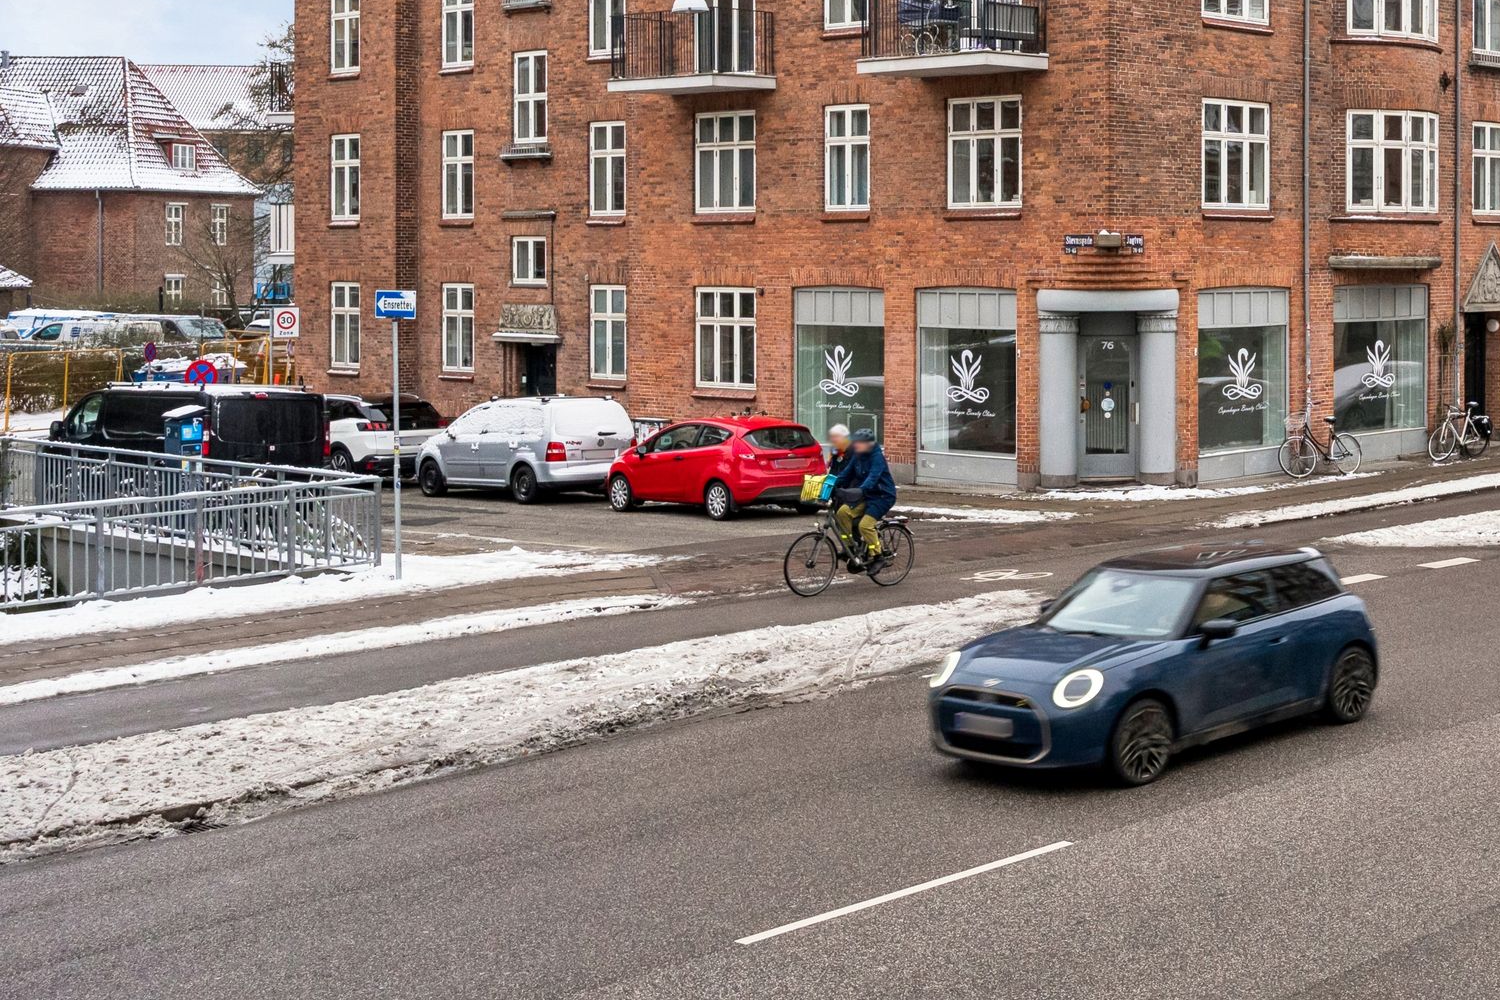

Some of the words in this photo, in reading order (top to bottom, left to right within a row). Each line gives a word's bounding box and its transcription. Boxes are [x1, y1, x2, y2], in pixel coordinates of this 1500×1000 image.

[280, 316, 293, 325] 30
[1101, 341, 1115, 350] 76
[815, 400, 837, 410] Copenhagen
[838, 401, 851, 411] Beauty
[1218, 406, 1240, 416] Copenhagen
[1240, 404, 1255, 413] Beauty
[965, 408, 981, 419] Beauty
